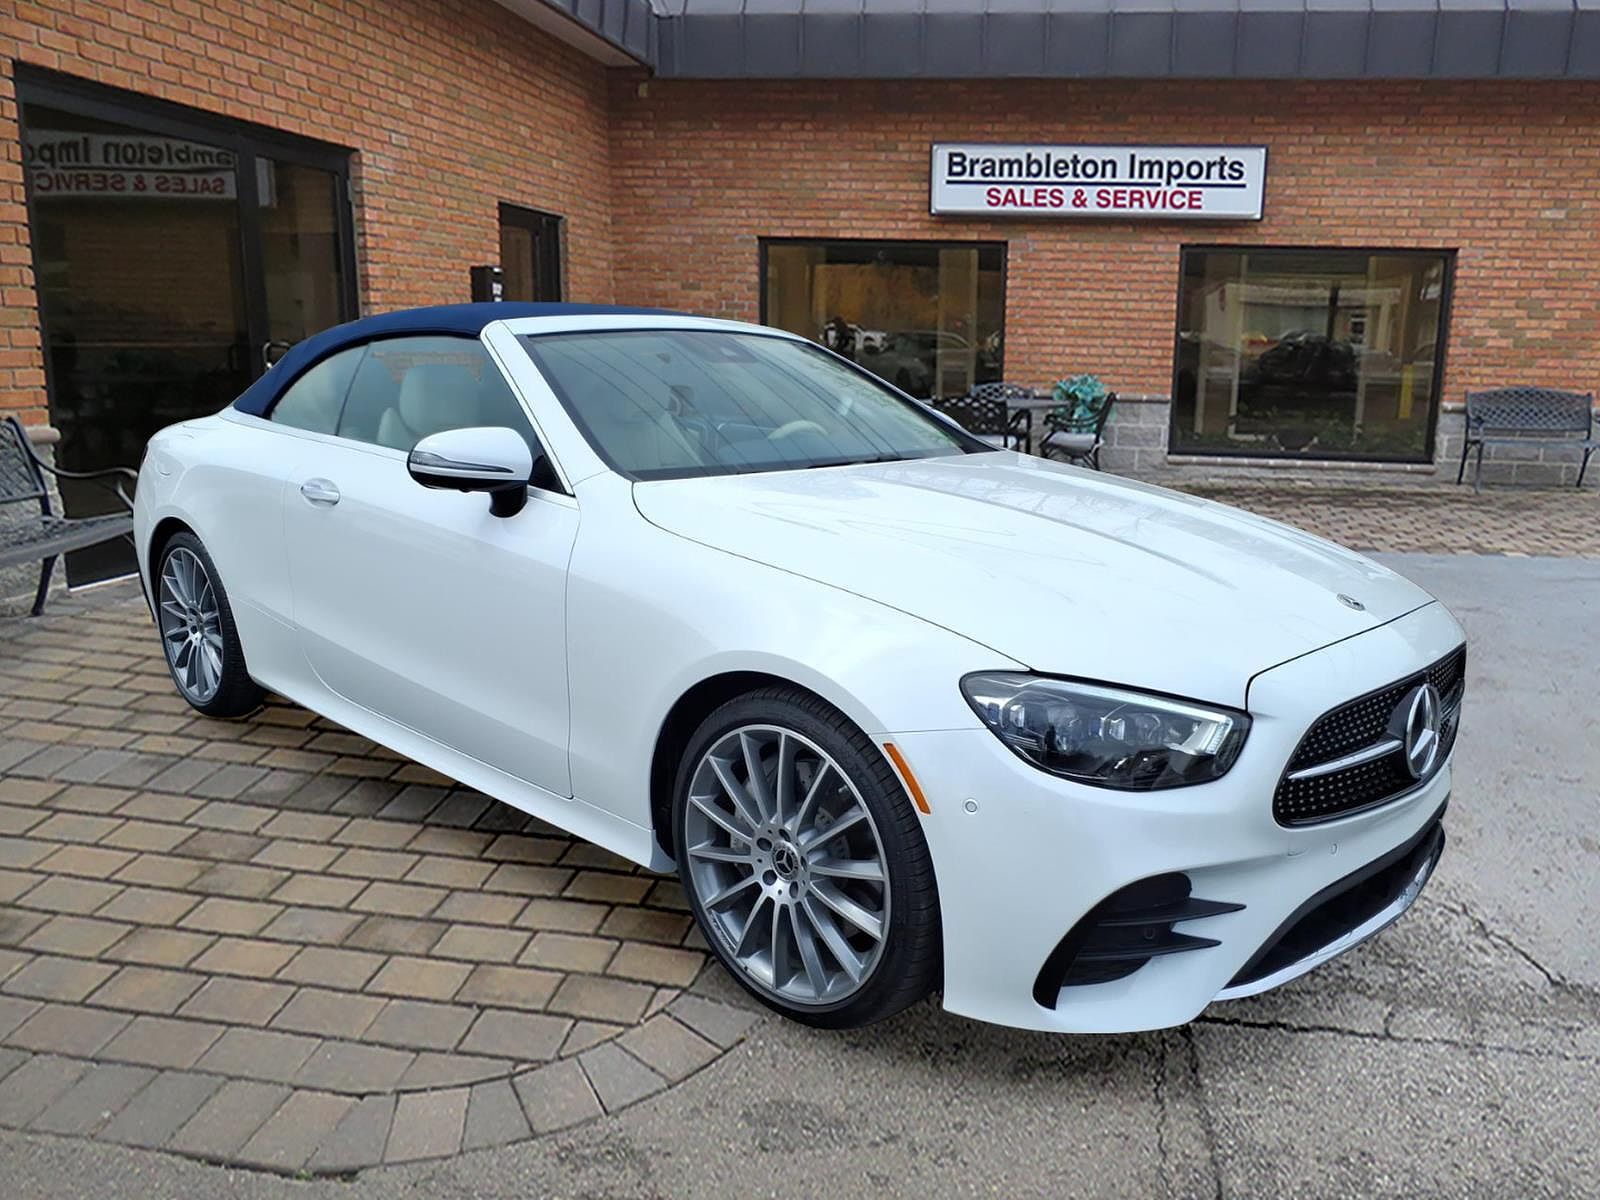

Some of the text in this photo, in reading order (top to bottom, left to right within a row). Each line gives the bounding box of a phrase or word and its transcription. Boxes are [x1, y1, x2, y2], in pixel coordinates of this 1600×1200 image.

[947, 151, 1245, 187] Brambleton Imports
[986, 187, 1203, 210] SALES & SERVICE
